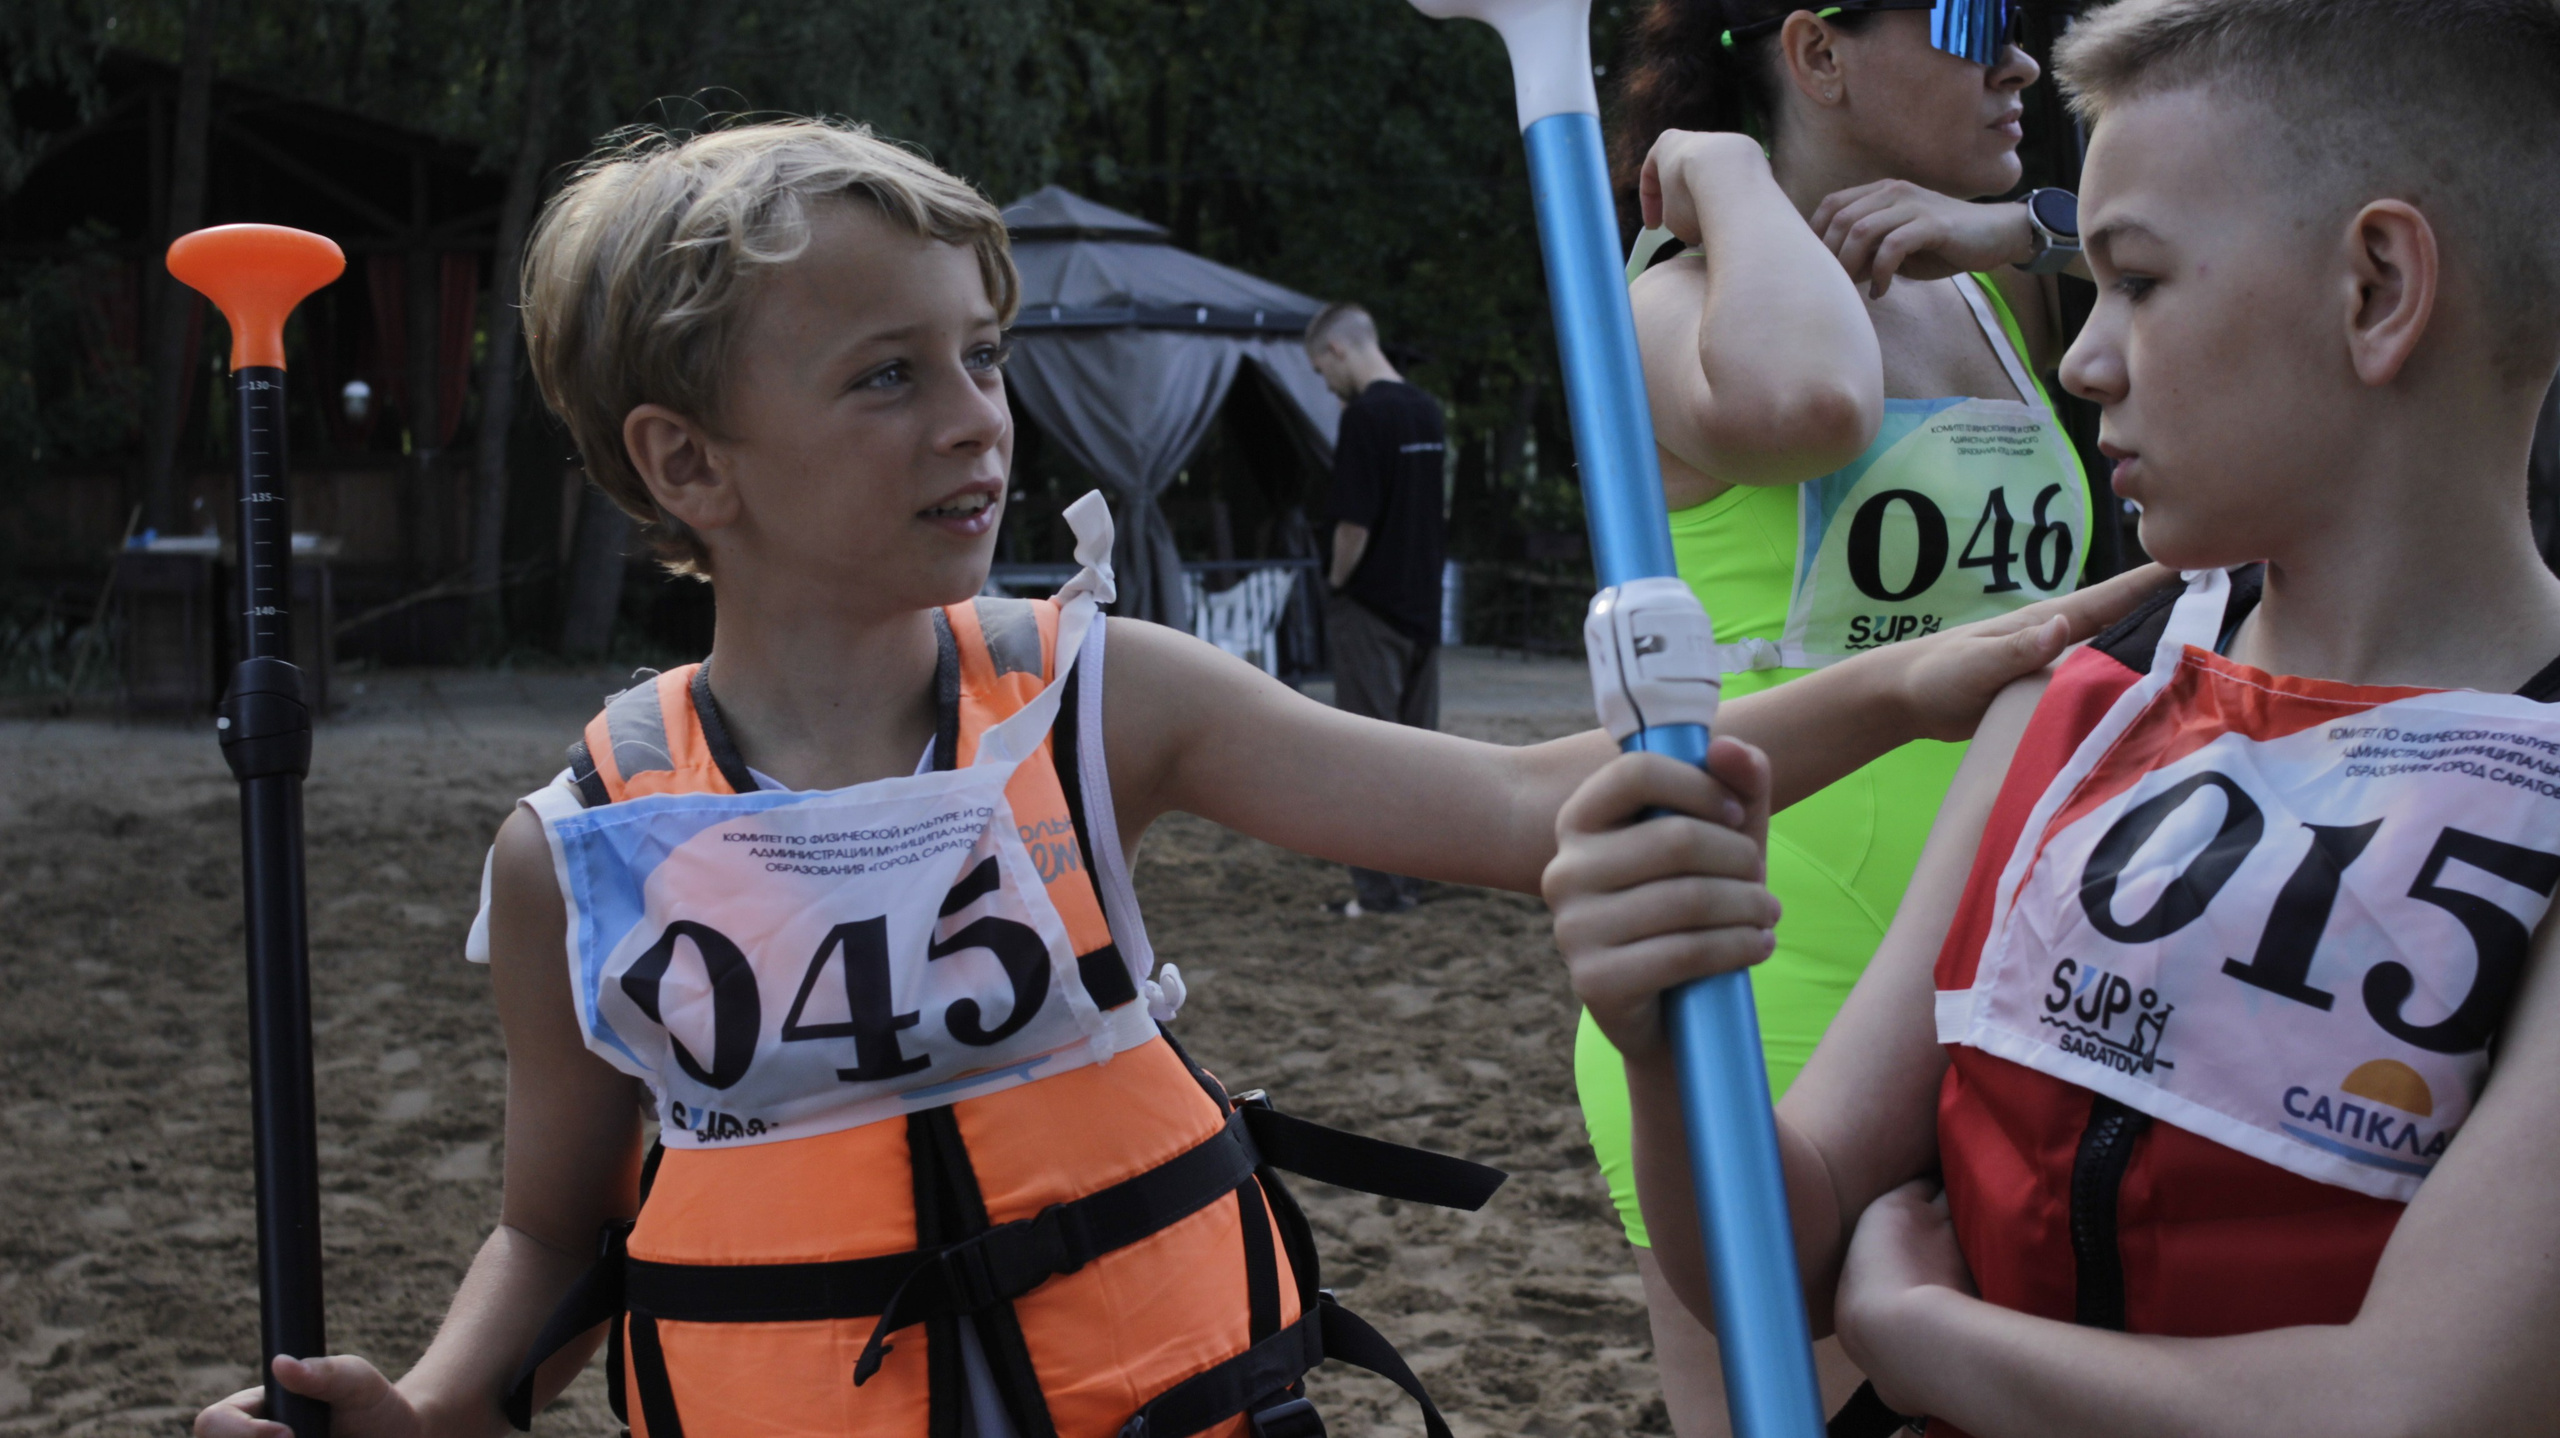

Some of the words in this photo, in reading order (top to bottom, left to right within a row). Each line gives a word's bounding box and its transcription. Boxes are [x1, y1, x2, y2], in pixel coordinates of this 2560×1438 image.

[248, 381, 270, 391] 130
[251, 492, 272, 502] 135
[1847, 482, 2074, 601] 046
[254, 606, 276, 616] 140
[1848, 614, 1919, 643] SUP
[722, 832, 783, 844] КОМИТЕТ
[785, 835, 807, 845] ПО
[808, 826, 900, 845] ФИЗИЧЕСКОЙ
[903, 811, 960, 837] КУЛЬТУРЕ
[963, 808, 973, 819] И
[749, 846, 874, 861] АДМИНИСТРАЦИИ
[765, 862, 866, 876] ОБРАЗОВАНИЯ
[2079, 770, 2560, 1055] 015
[620, 855, 1052, 1091] 045
[2045, 957, 2132, 1031] SUP
[2059, 1033, 2142, 1077] SARATOV
